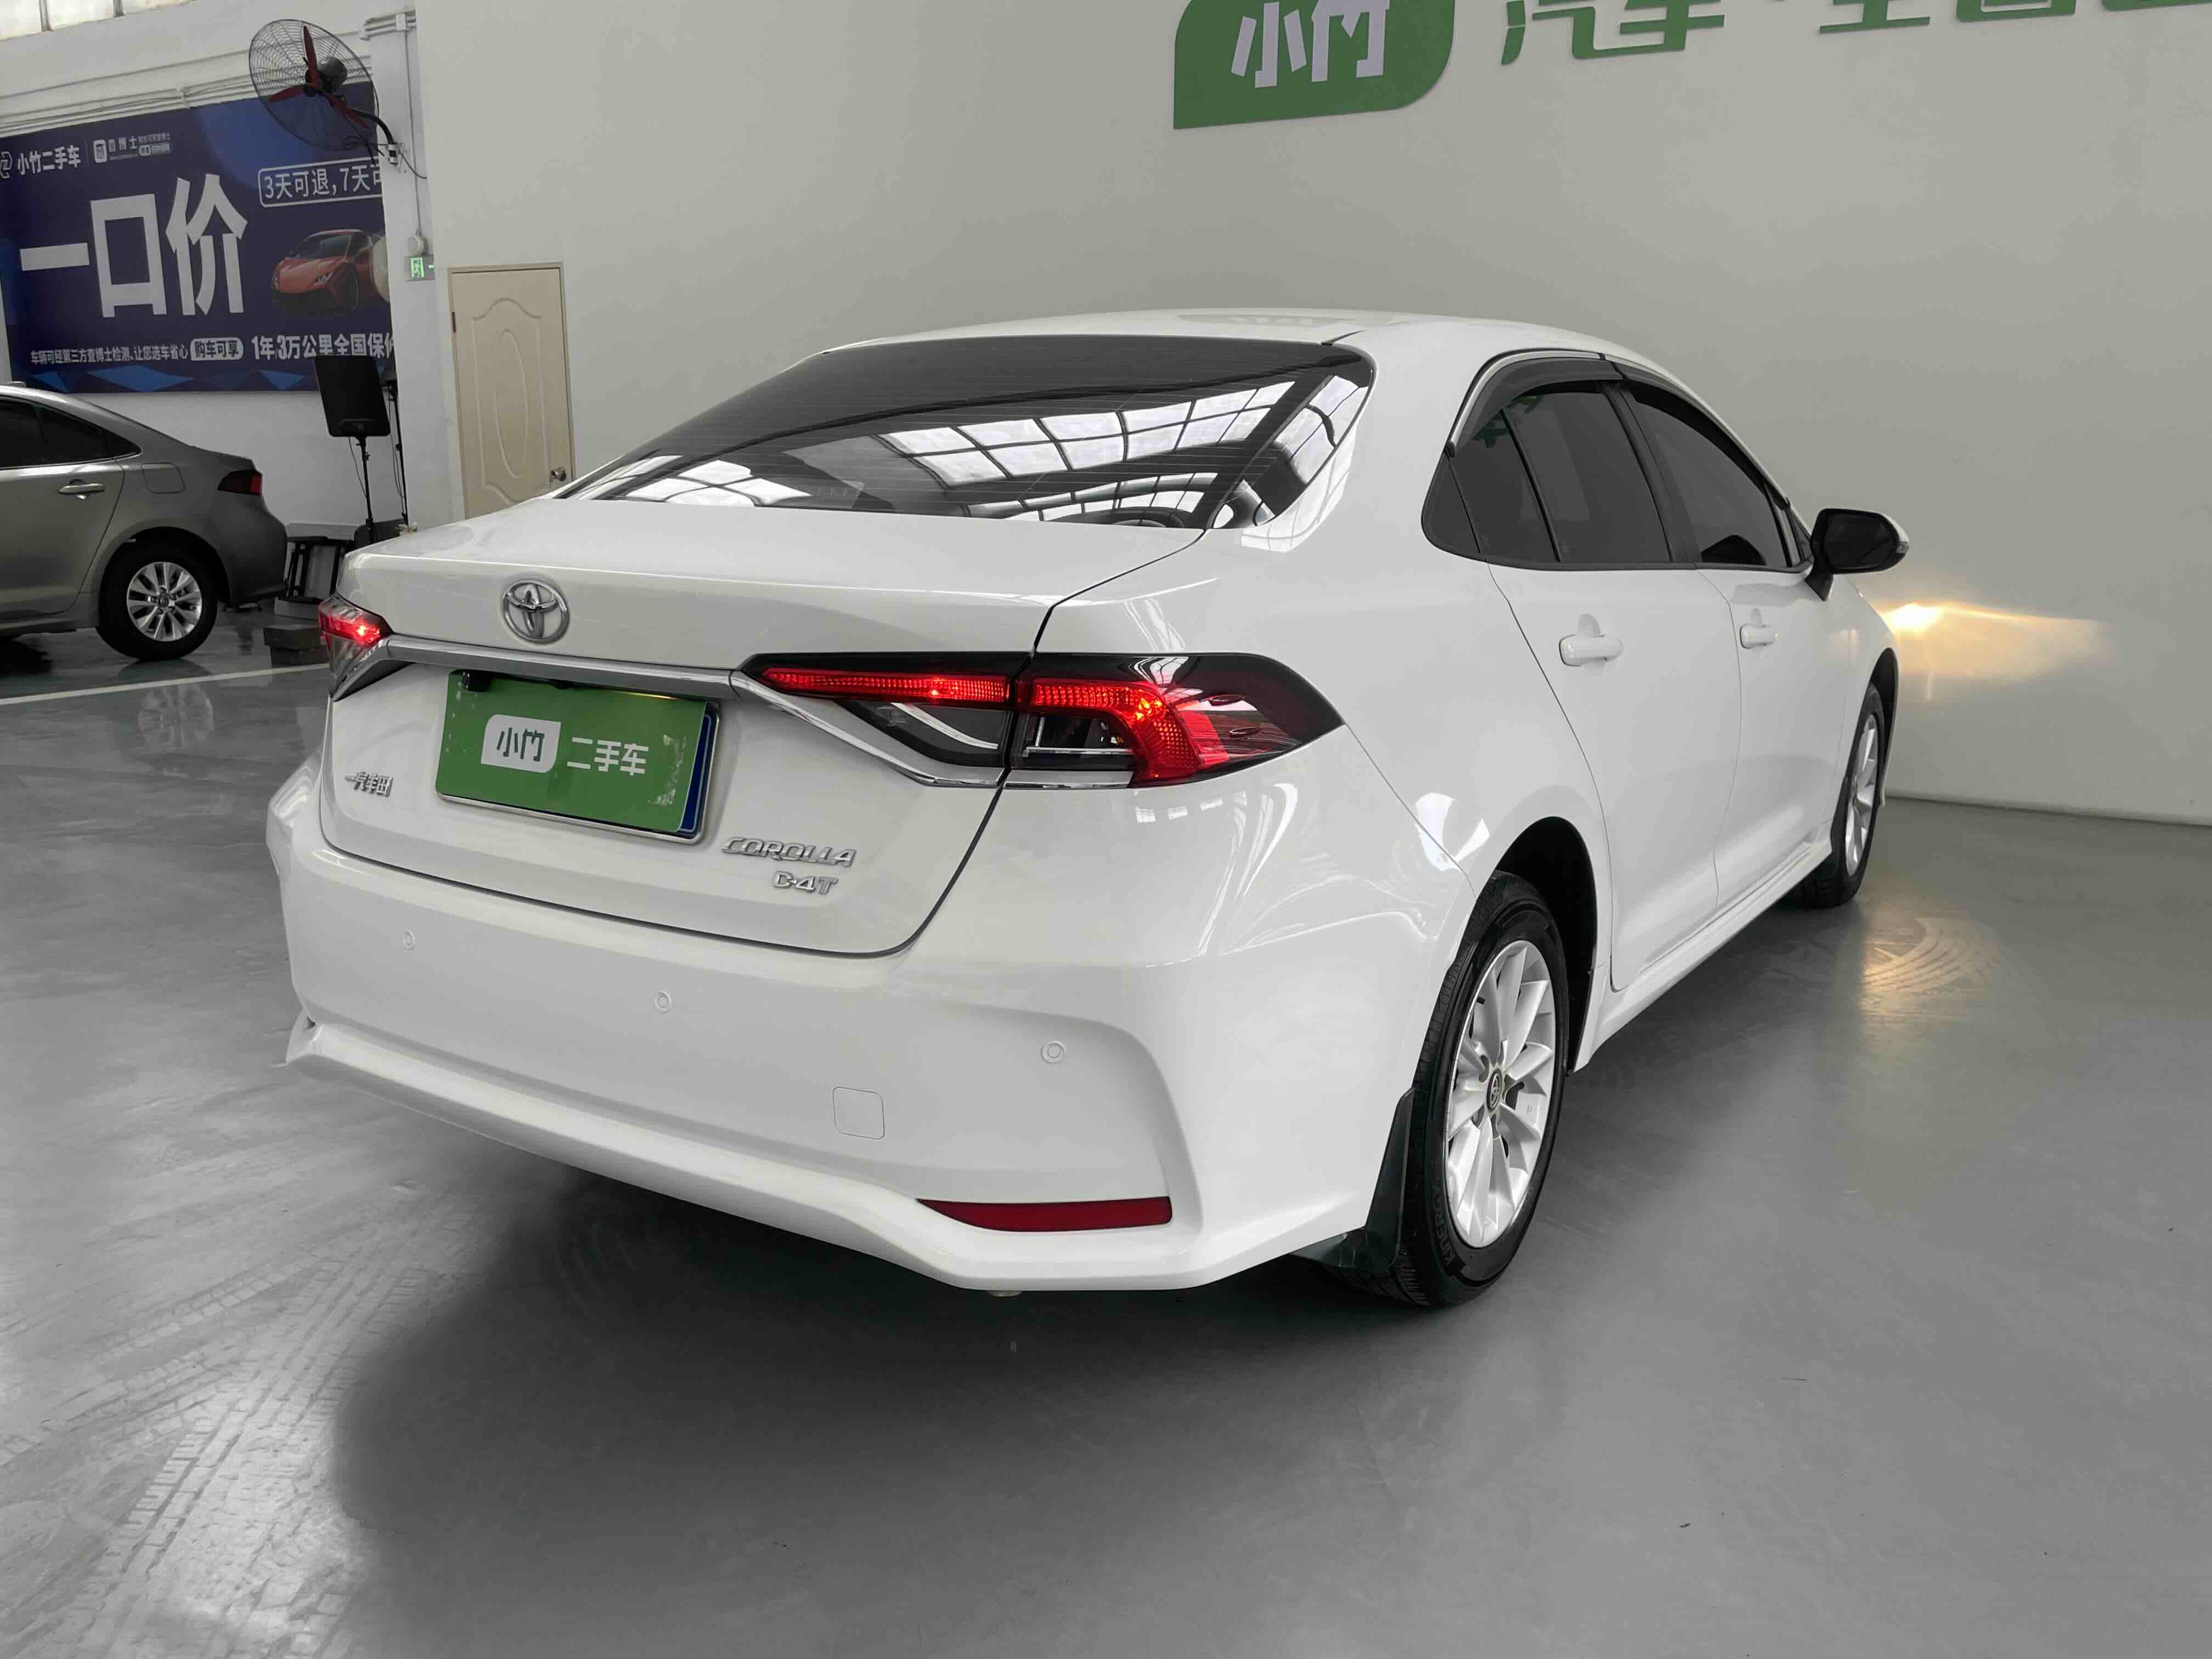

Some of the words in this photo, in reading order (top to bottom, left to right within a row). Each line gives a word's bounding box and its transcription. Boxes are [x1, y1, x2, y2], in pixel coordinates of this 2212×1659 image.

[1231, 0, 1390, 88] 小竹
[18, 144, 81, 175] 小竹二手车
[20, 174, 248, 317] 一口价
[194, 339, 239, 359] 购车可享
[496, 727, 545, 762] 小竹
[567, 737, 649, 776] 二手车
[721, 836, 857, 867] COROLLA
